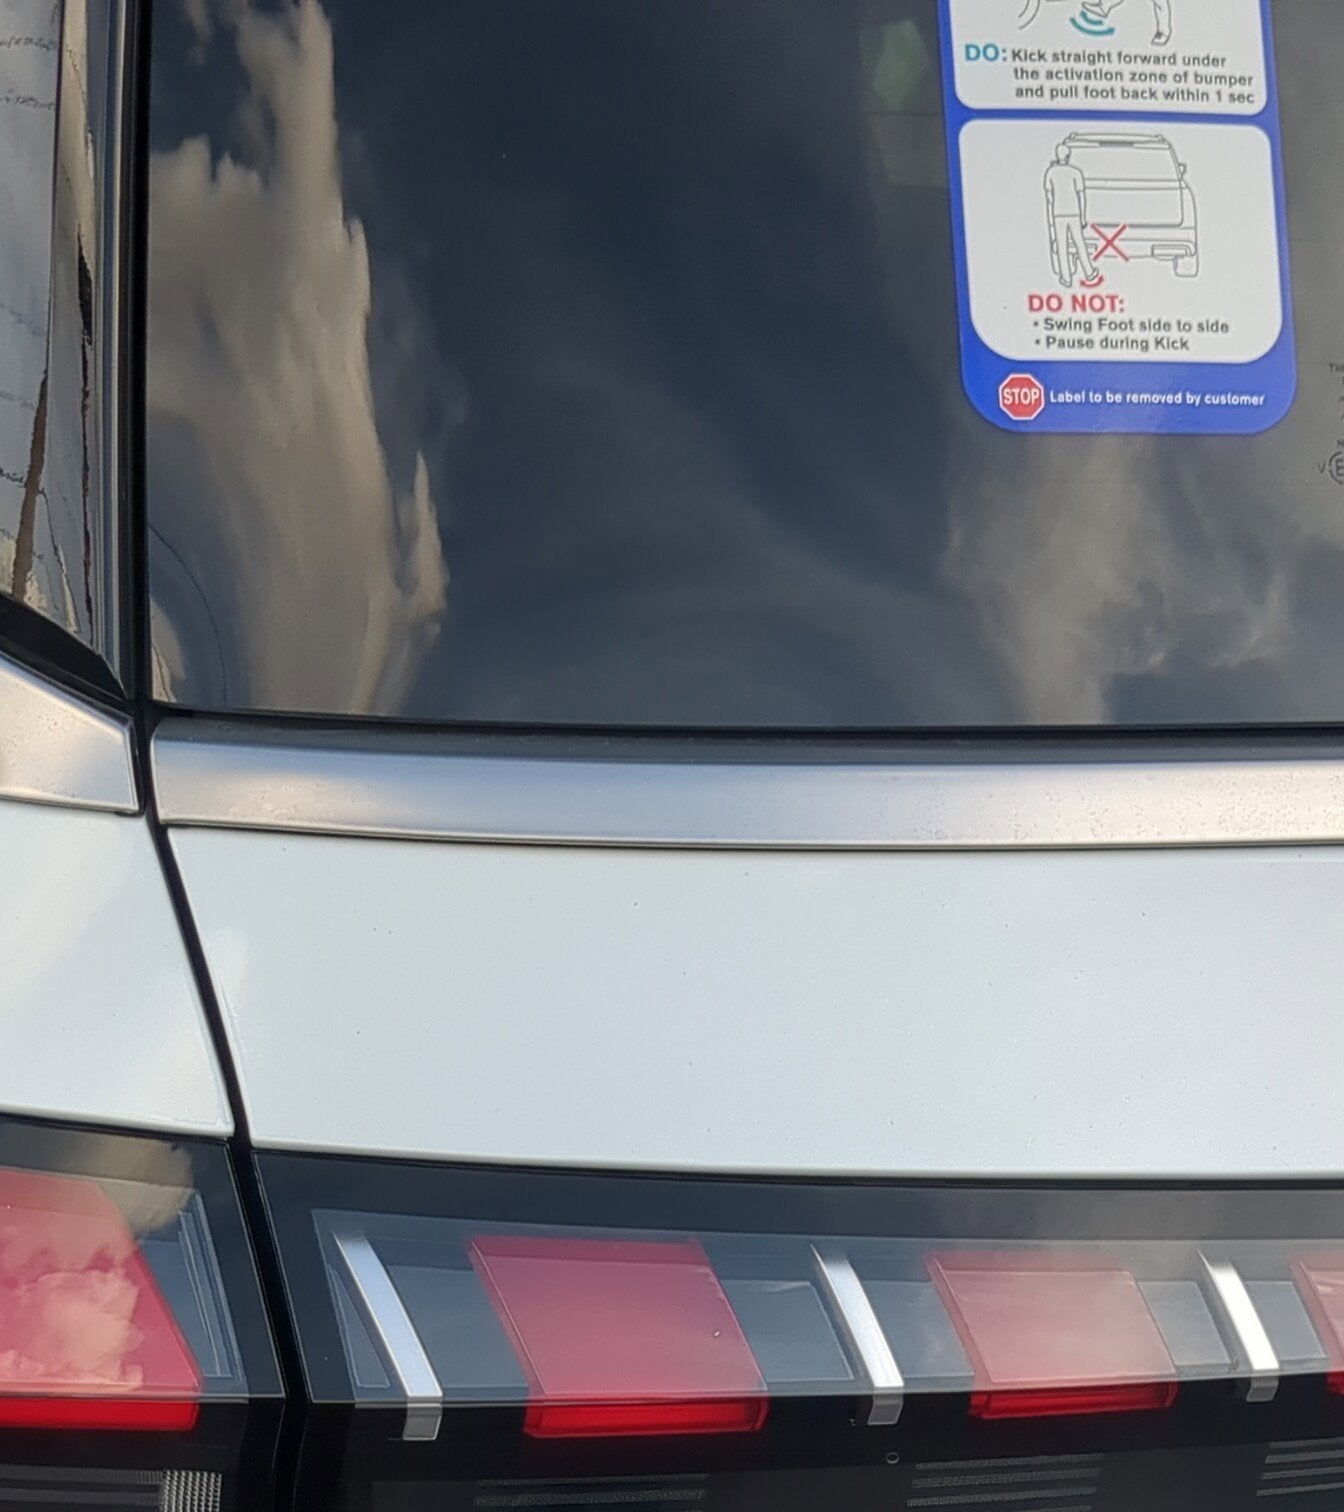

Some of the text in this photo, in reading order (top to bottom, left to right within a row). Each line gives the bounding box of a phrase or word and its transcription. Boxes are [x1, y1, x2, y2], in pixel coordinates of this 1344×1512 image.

[964, 43, 1226, 68] DO: Kick straight forward under
[1014, 67, 1253, 88] the activation zone of bumper
[1016, 85, 1255, 104] and pull foot back within 1 sec
[1028, 294, 1124, 313] DO NOT:
[1044, 317, 1229, 333] Swing Foot side to side
[1046, 336, 1189, 351] Pause during Kick
[1003, 388, 1040, 405] STOP
[1050, 391, 1265, 406] Label to be removed by customer
